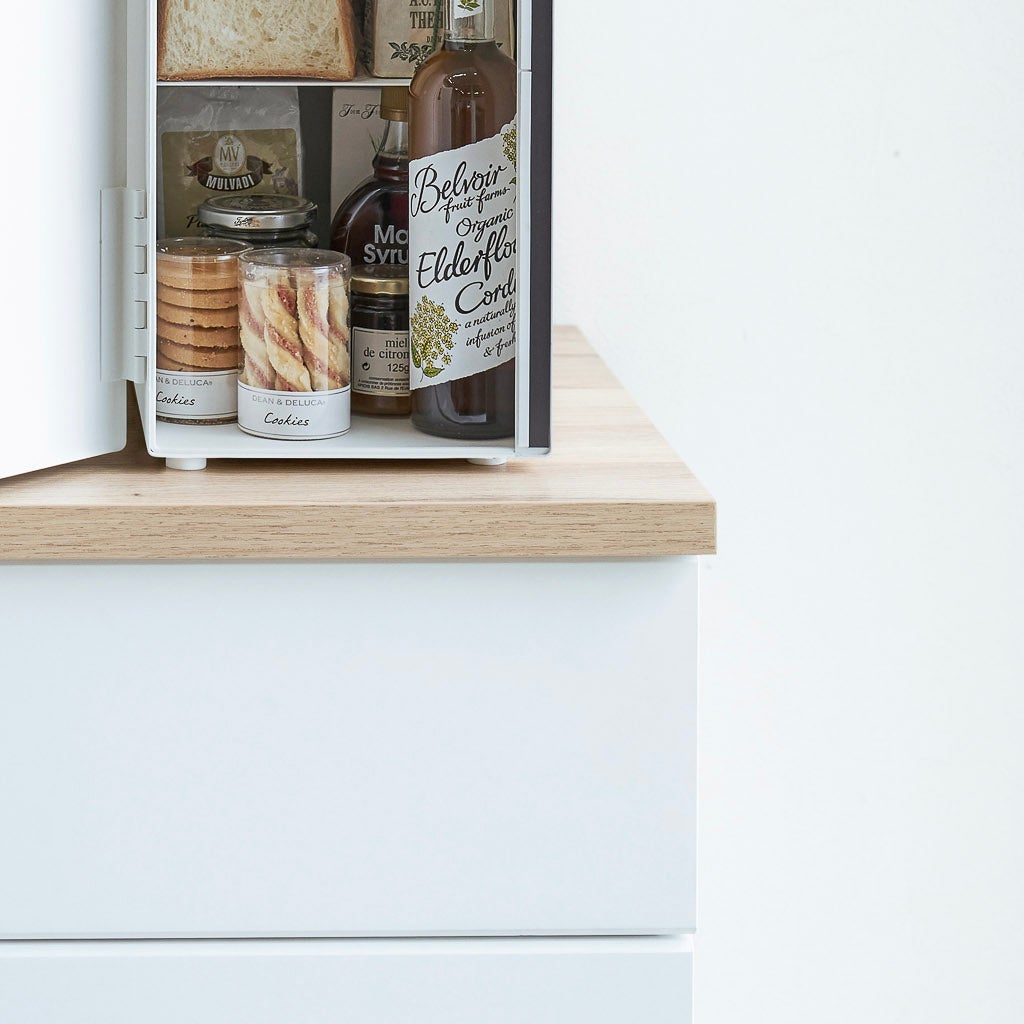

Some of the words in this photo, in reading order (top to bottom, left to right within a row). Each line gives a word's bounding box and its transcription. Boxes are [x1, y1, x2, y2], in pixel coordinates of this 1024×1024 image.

[205, 174, 256, 191] MULVADI
[410, 161, 508, 218] Belvoir
[438, 196, 475, 224] fruit
[476, 187, 511, 214] farms
[374, 224, 408, 245] Ma
[456, 208, 514, 243] Organic
[363, 243, 408, 265] Syru
[416, 224, 517, 289] Elderflo
[385, 337, 408, 348] miel
[465, 326, 506, 349] infusion
[363, 346, 375, 358] de
[378, 348, 409, 359] citron
[483, 346, 495, 358] &
[156, 390, 196, 406] Cookies
[252, 394, 274, 405] DEAN
[276, 398, 283, 406] &
[264, 412, 310, 426] Cookies
